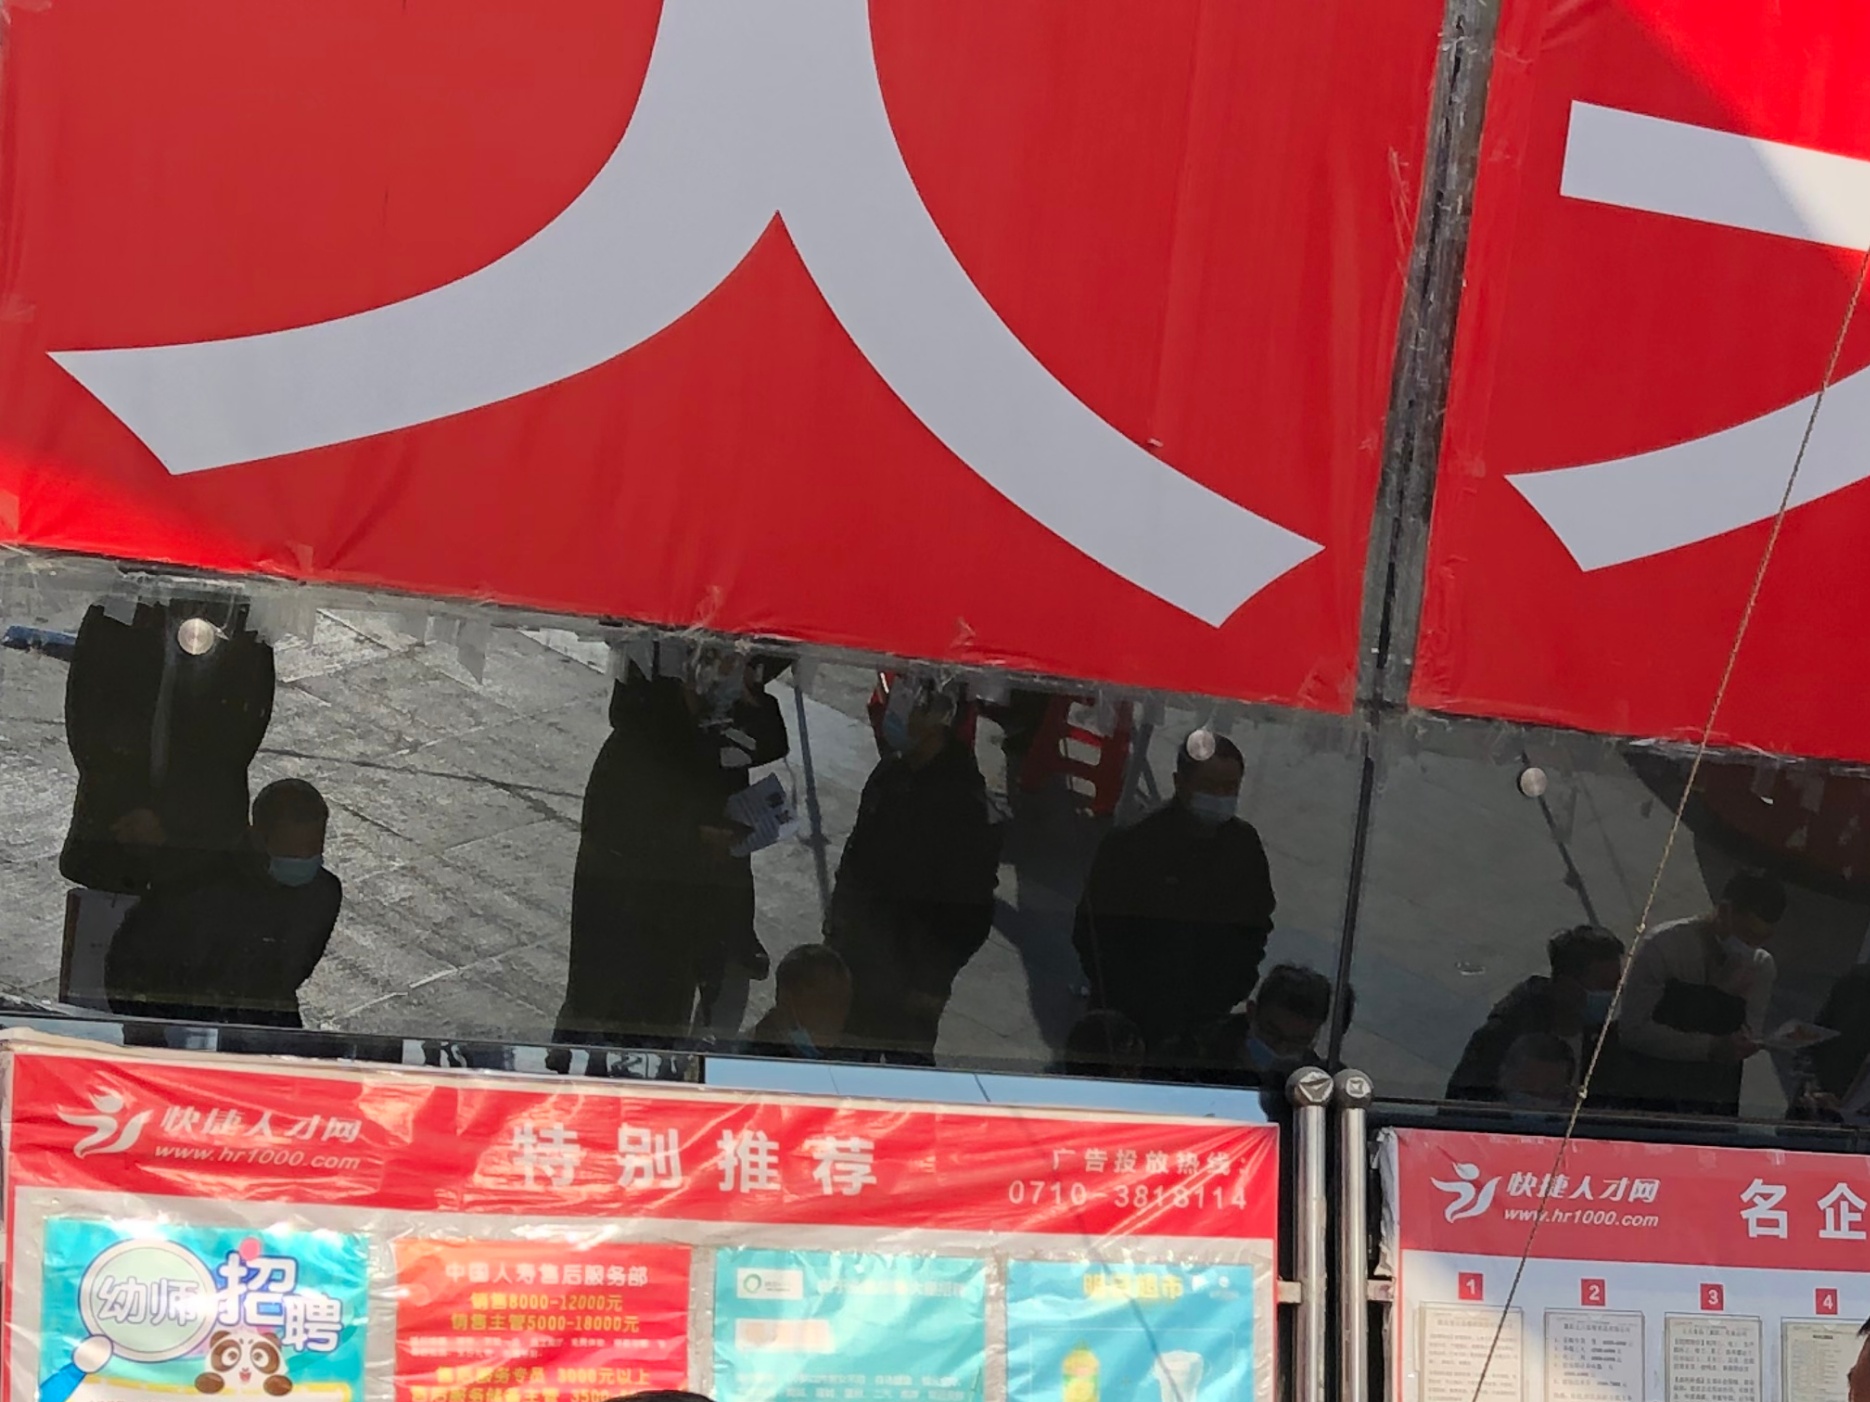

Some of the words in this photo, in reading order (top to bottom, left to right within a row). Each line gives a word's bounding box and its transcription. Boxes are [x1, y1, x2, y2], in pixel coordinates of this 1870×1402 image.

[160, 1104, 362, 1142] 快捷人才网
[155, 1142, 360, 1171] www.hr1000.com
[512, 1122, 876, 1196] 特别推荐
[1008, 1180, 1247, 1210] 0710-3818114
[1506, 1171, 1660, 1203] 快捷人才网
[1504, 1207, 1660, 1228] www.hr1000.com
[446, 1262, 648, 1287] 中国人寿售后服务部
[1466, 1279, 1476, 1295] 1
[96, 1273, 198, 1328] 幼师
[216, 1249, 343, 1353] 招聘
[1589, 1285, 1600, 1301] 2
[1708, 1290, 1719, 1305] 3
[1823, 1295, 1834, 1310] 4
